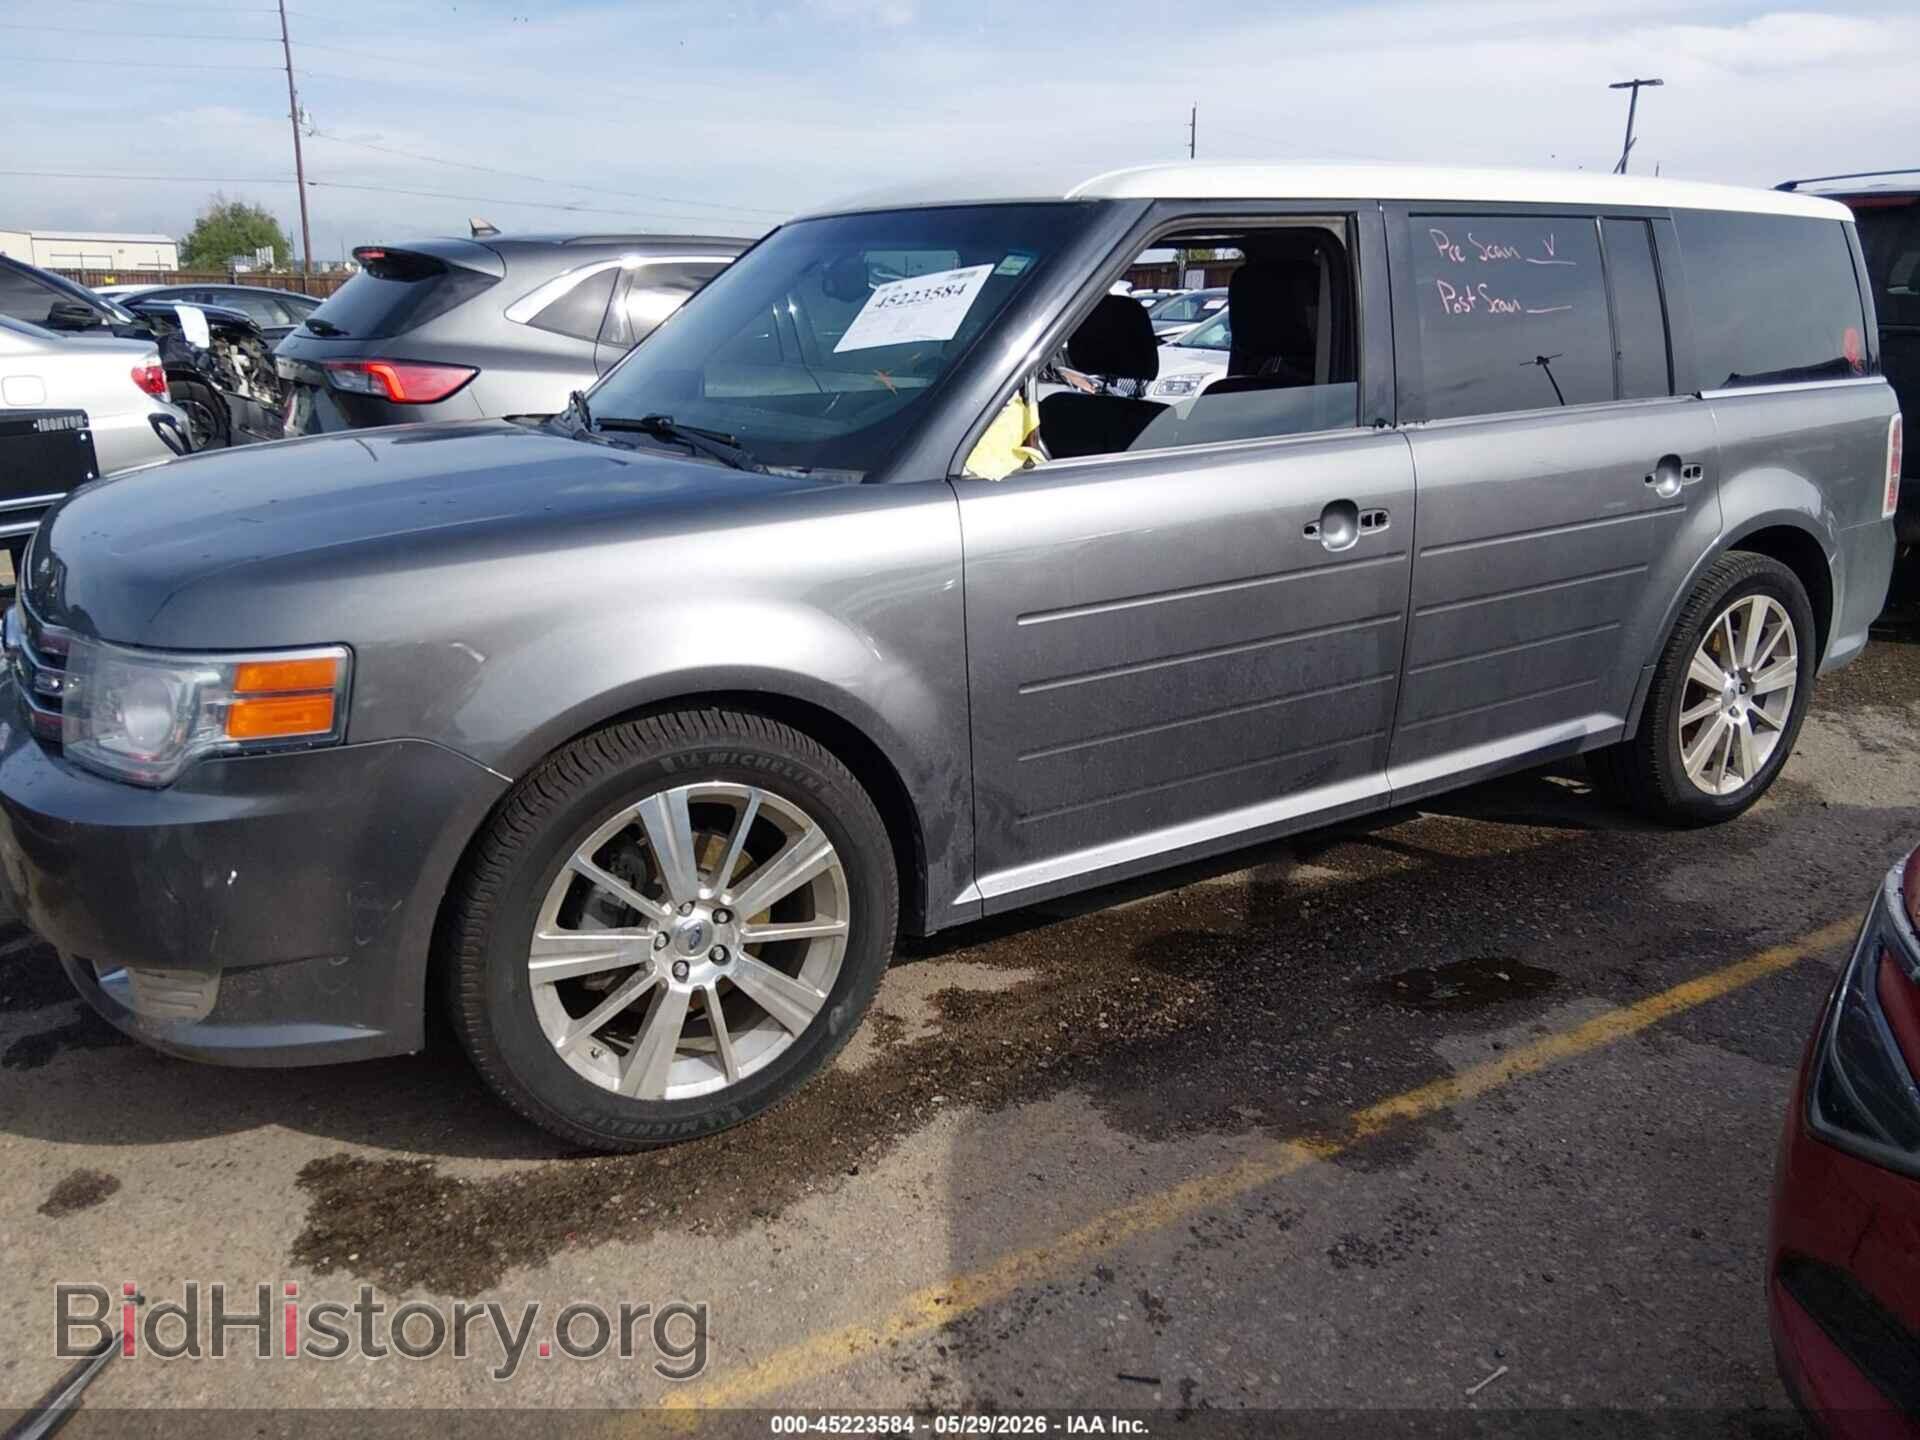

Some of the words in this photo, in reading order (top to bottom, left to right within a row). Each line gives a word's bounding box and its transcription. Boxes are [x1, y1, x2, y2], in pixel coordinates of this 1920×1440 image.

[1429, 228, 1466, 263] Pre
[1468, 232, 1521, 262] Scan
[874, 282, 968, 309] 45223584
[1436, 279, 1476, 315] Post
[1478, 283, 1521, 313] Scan
[707, 751, 822, 793] MICHELIN
